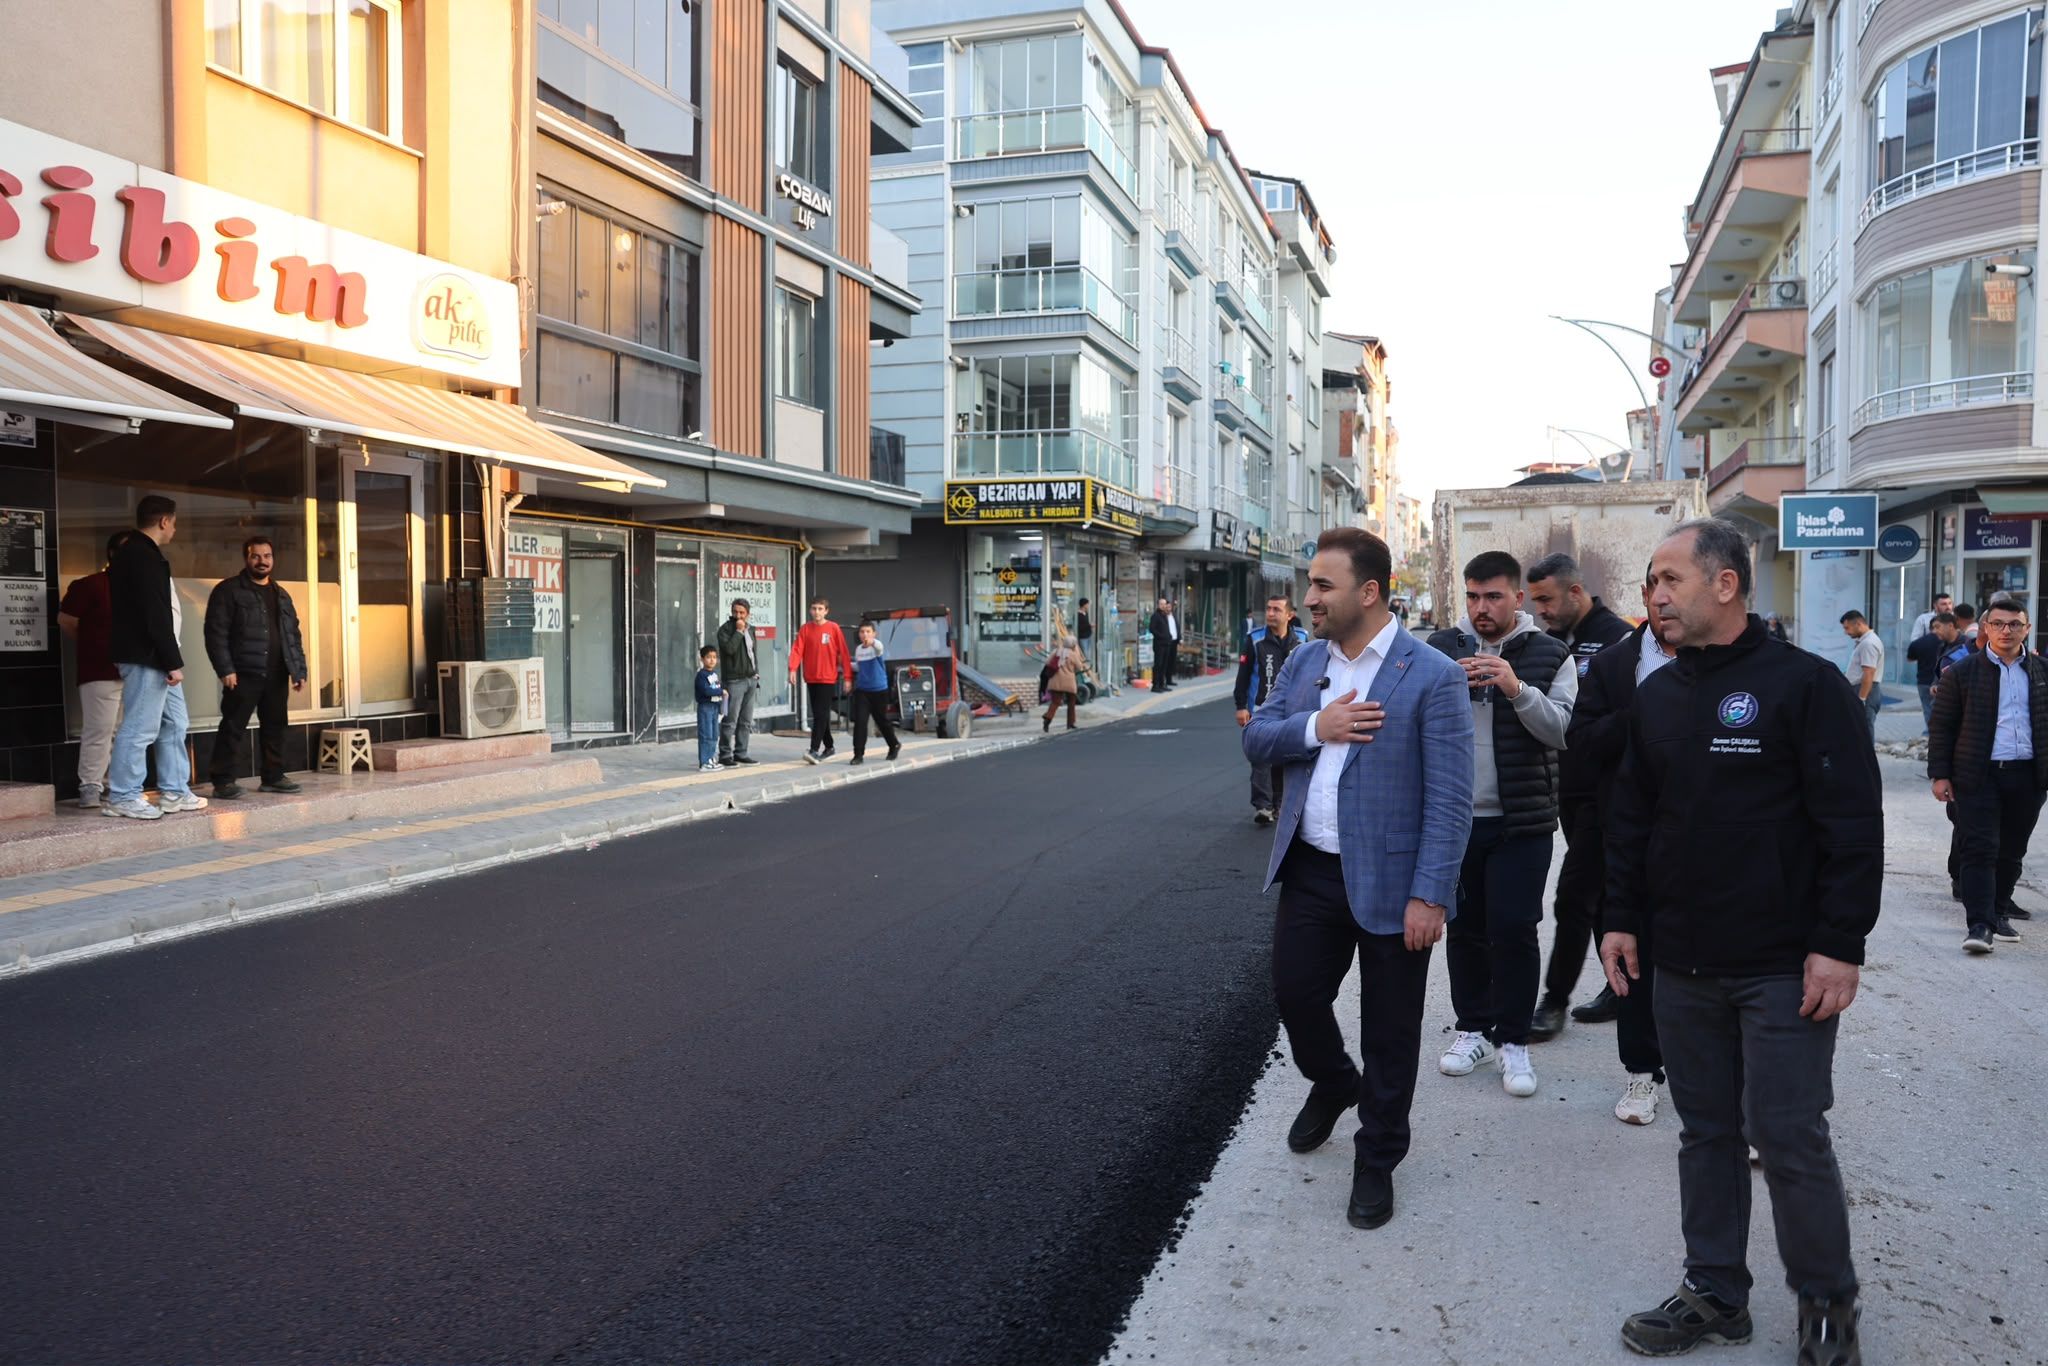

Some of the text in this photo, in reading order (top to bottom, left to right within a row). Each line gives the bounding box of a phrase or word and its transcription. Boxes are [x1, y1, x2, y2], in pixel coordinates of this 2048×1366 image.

[781, 174, 832, 217] ÇOBAN
[798, 206, 816, 231] Life
[424, 286, 462, 324] ak
[448, 320, 485, 349] piliç
[1050, 482, 1081, 500] YAPI
[1029, 505, 1037, 517] &
[1042, 506, 1080, 517] HIRDAVAT
[1796, 511, 1828, 527] İhlas
[1796, 525, 1865, 537] Pazarlama
[1981, 535, 2019, 547] Cebilon
[4, 583, 39, 592] KIZARMIŞ
[724, 580, 772, 594] 0544 601 05 18
[1019, 586, 1039, 595] YAPI
[9, 594, 35, 602] TAVUK
[4, 605, 40, 613] BULUNUR
[9, 618, 36, 626] KANAT
[547, 608, 561, 629] 20
[15, 628, 32, 637] BUT
[4, 640, 42, 648] BULUNUR
